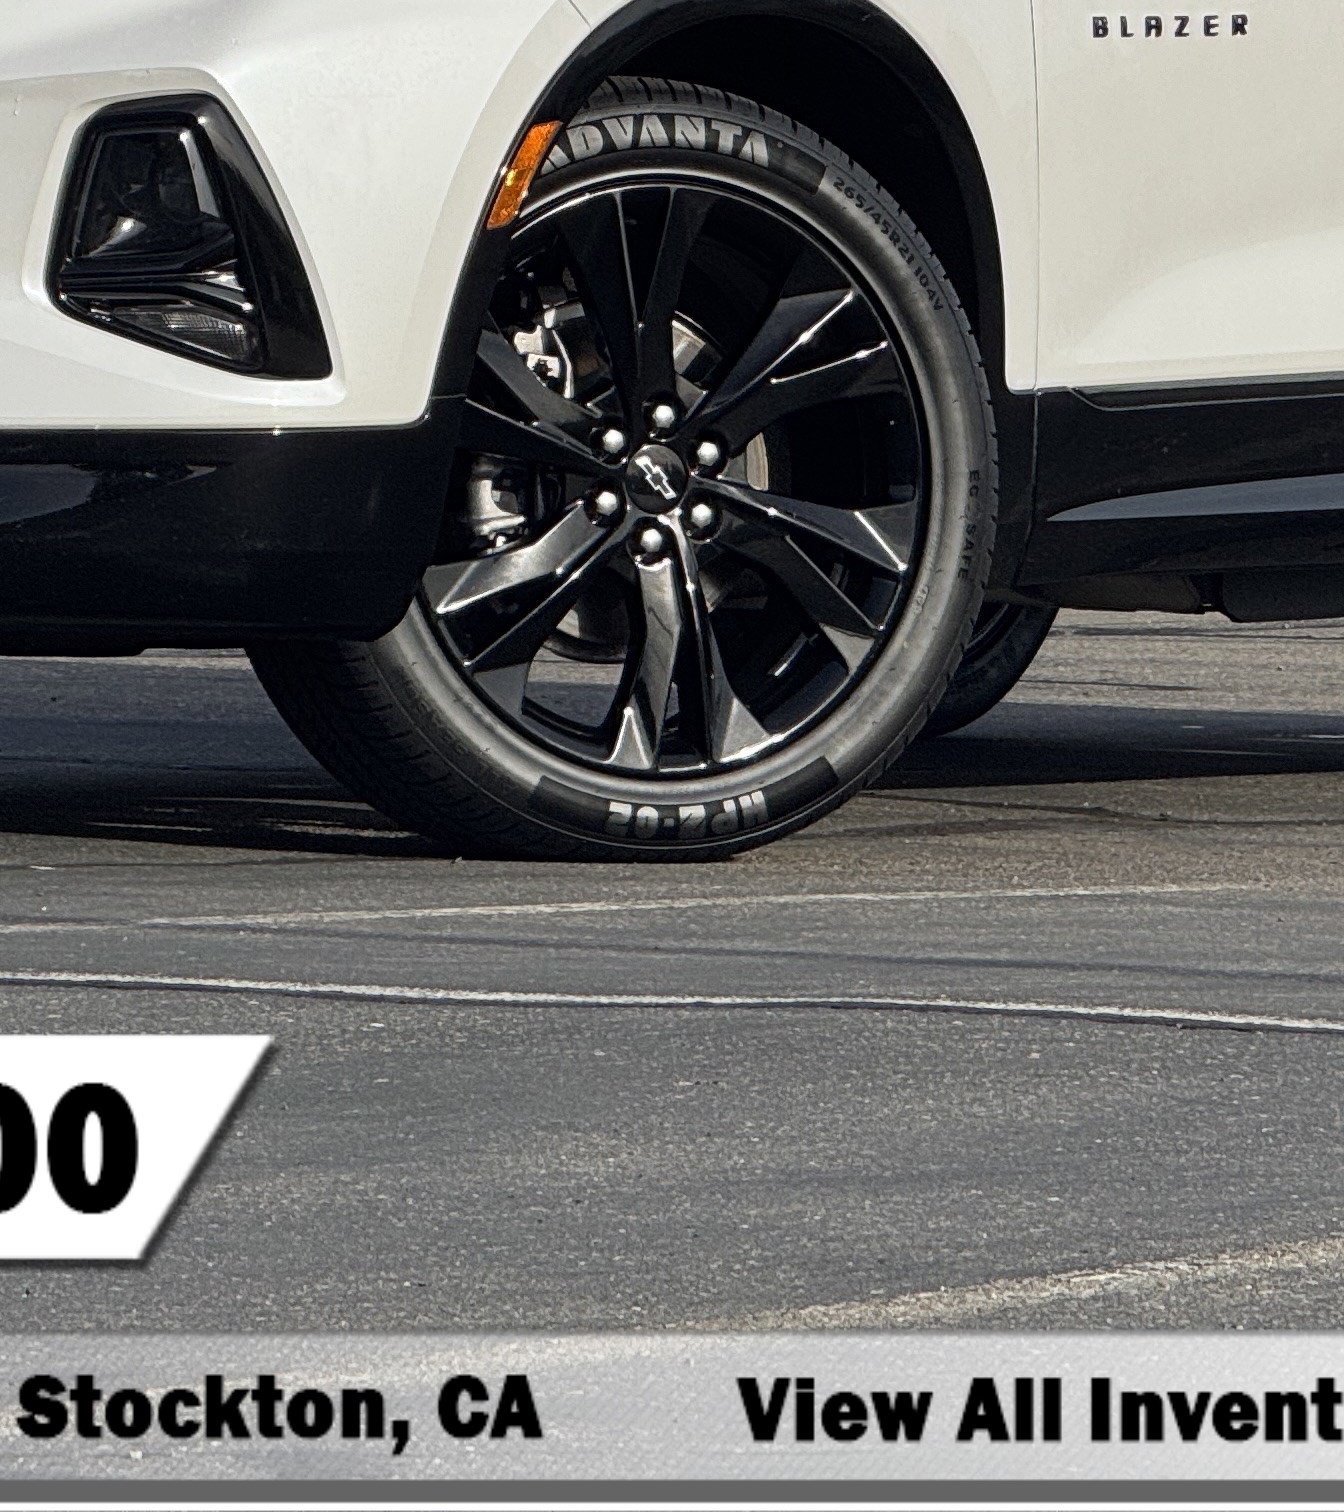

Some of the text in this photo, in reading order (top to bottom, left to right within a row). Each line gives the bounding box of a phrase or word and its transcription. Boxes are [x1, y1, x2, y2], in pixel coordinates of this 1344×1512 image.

[1092, 14, 1249, 38] BLAZER
[541, 114, 769, 175] ADVANTA
[833, 176, 915, 266] 265/45R21
[958, 523, 977, 580] SAFE
[604, 789, 768, 839] HPZ-02
